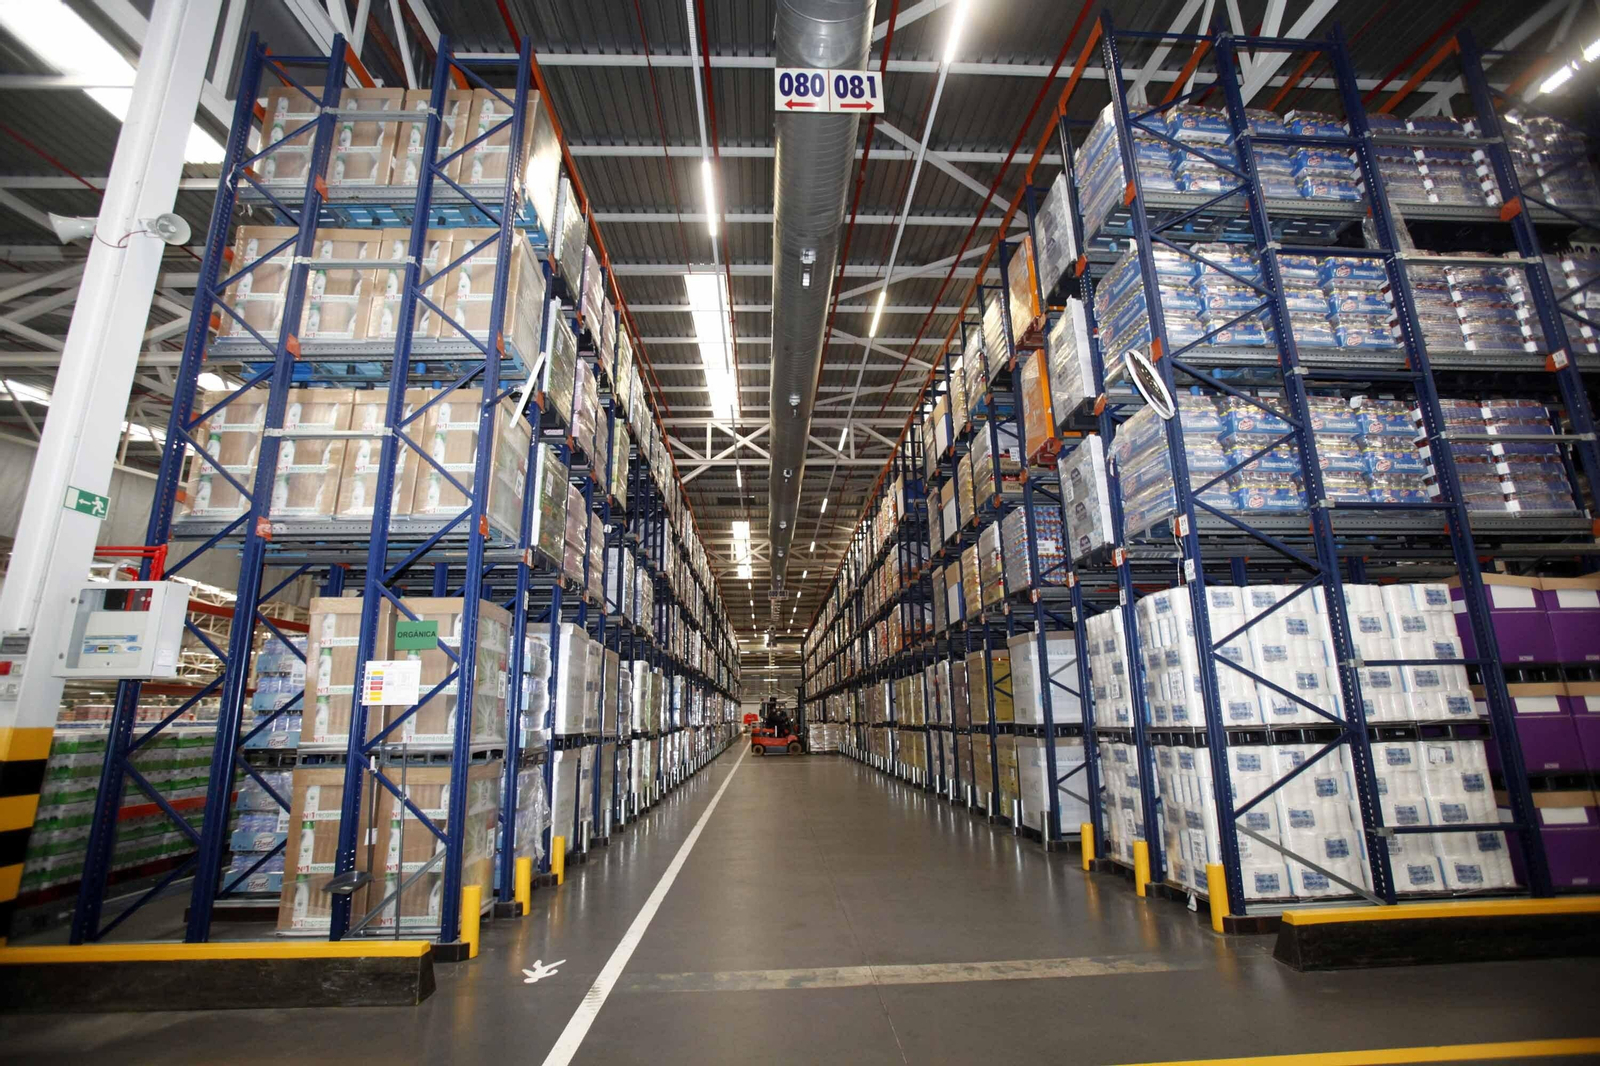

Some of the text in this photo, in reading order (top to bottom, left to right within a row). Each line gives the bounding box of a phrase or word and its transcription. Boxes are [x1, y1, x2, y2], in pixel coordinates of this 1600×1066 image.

[780, 72, 876, 98] 080 081
[398, 630, 436, 638] ORGÁNICA
